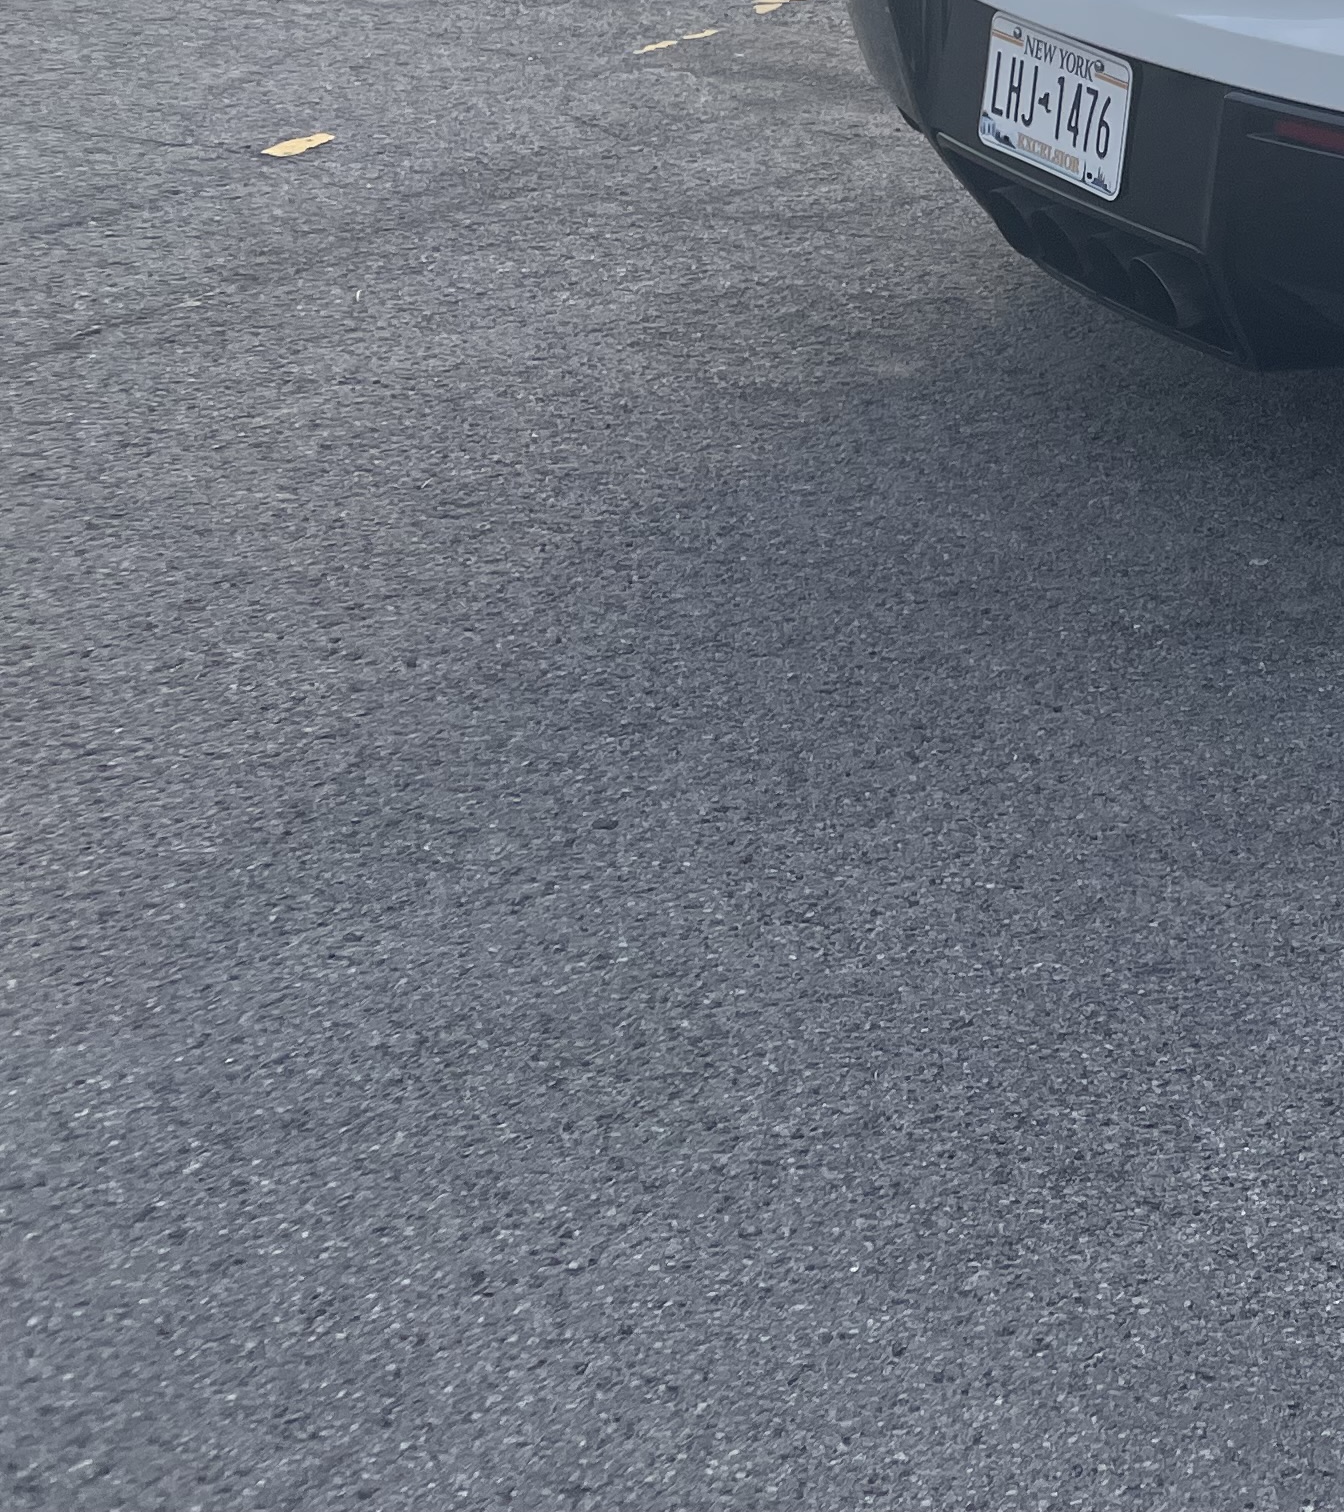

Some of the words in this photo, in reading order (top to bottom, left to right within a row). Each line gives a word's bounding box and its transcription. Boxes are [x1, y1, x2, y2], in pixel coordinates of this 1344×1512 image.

[1023, 34, 1057, 65] NEW
[1059, 45, 1095, 82] YORK
[991, 51, 1039, 127] LHJ
[1055, 76, 1111, 159] 1476
[1017, 132, 1080, 174] EXCELSIOR
